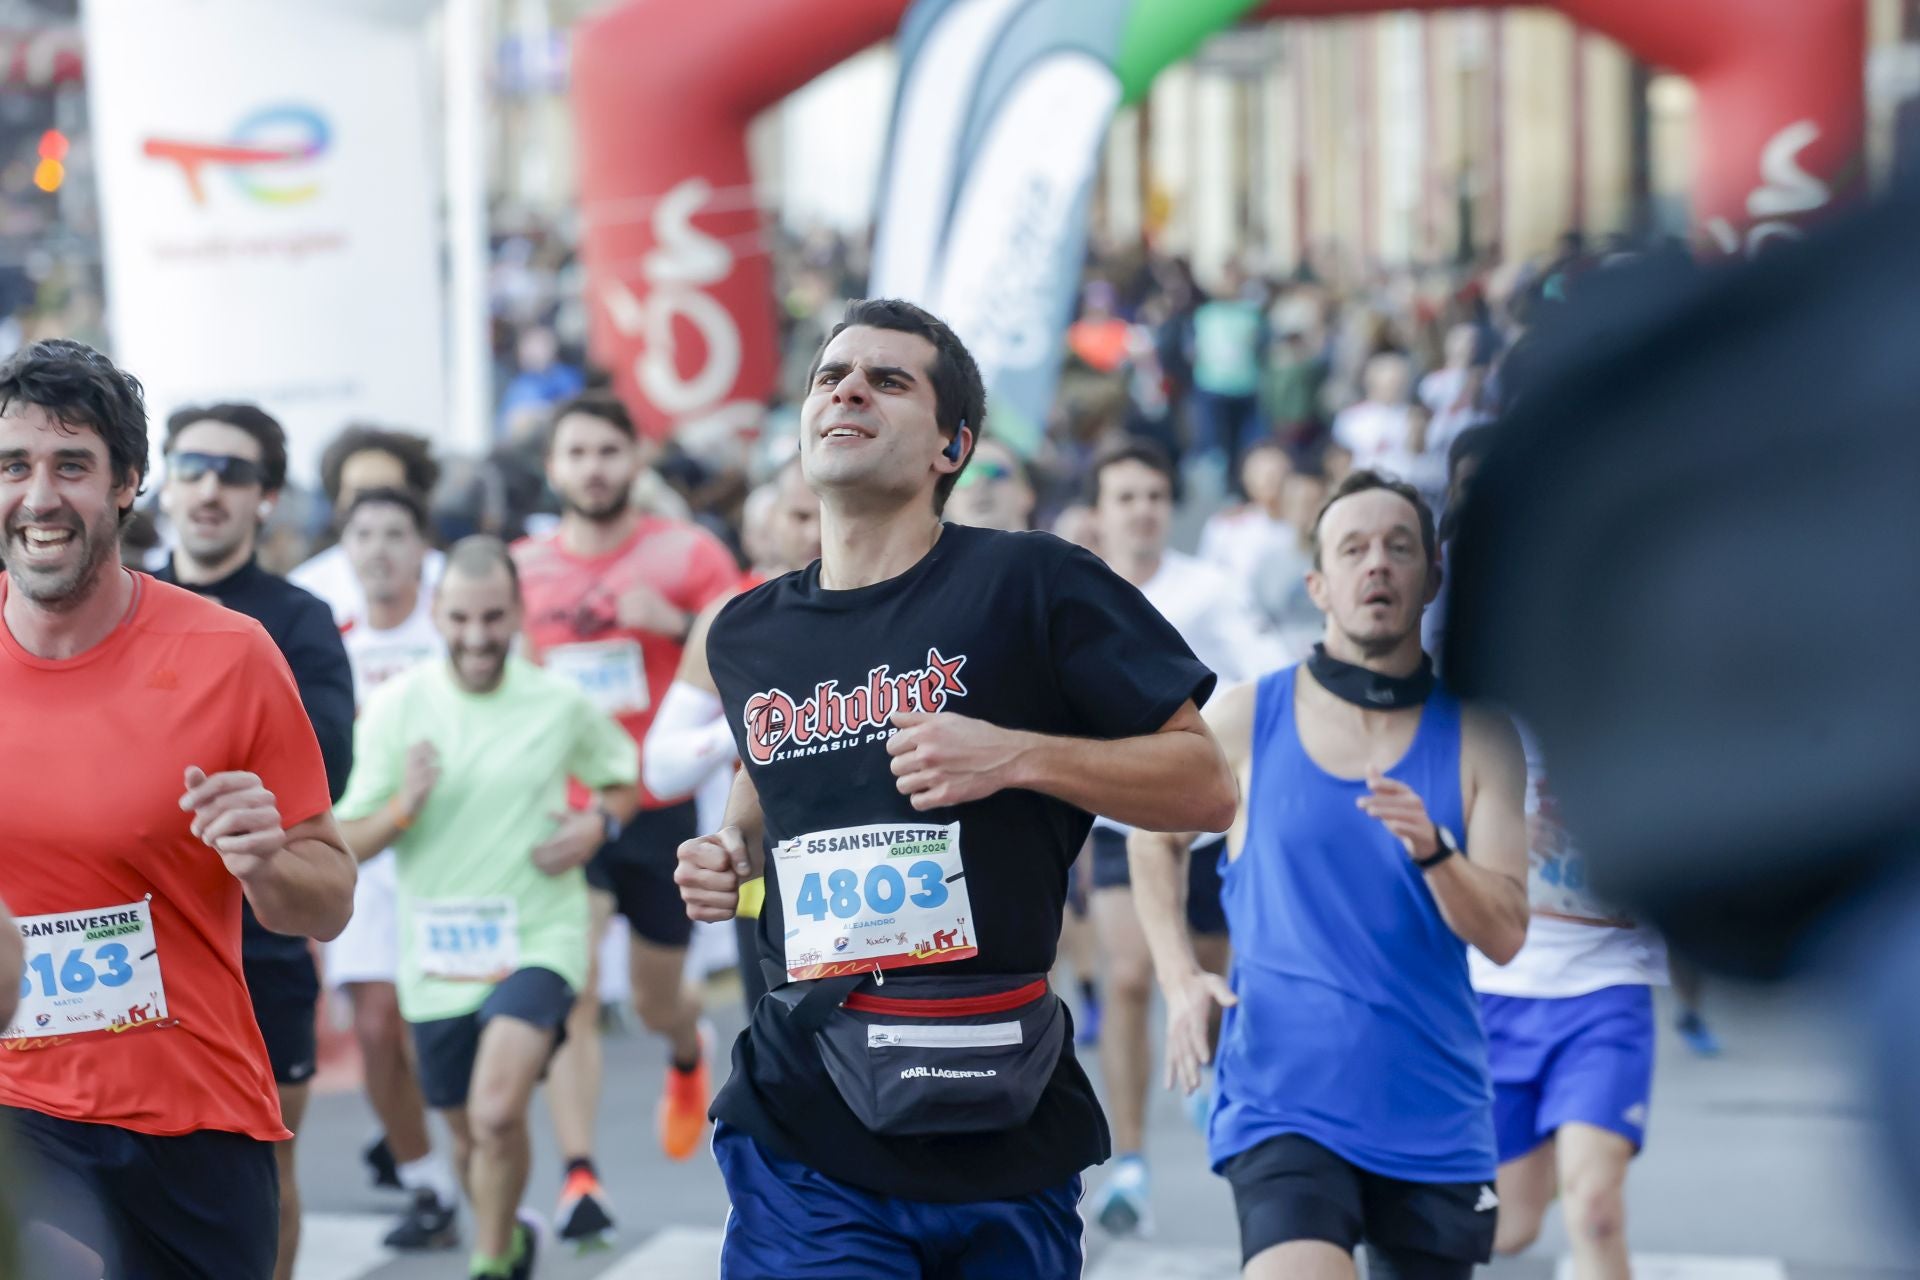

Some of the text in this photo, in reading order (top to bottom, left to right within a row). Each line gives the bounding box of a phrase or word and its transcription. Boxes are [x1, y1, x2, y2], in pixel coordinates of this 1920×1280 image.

[744, 664, 948, 765] Ochobre
[776, 727, 899, 761] XIMNASIU POP
[807, 829, 948, 854] 55 SAN SILVESTRE
[891, 844, 946, 856] GIJÓN 2024
[796, 860, 949, 921] 4803
[21, 910, 140, 937] SAN SILVESTRE
[843, 917, 896, 930] ALEJANDRO
[901, 1066, 997, 1080] KARL LAGERFELD
